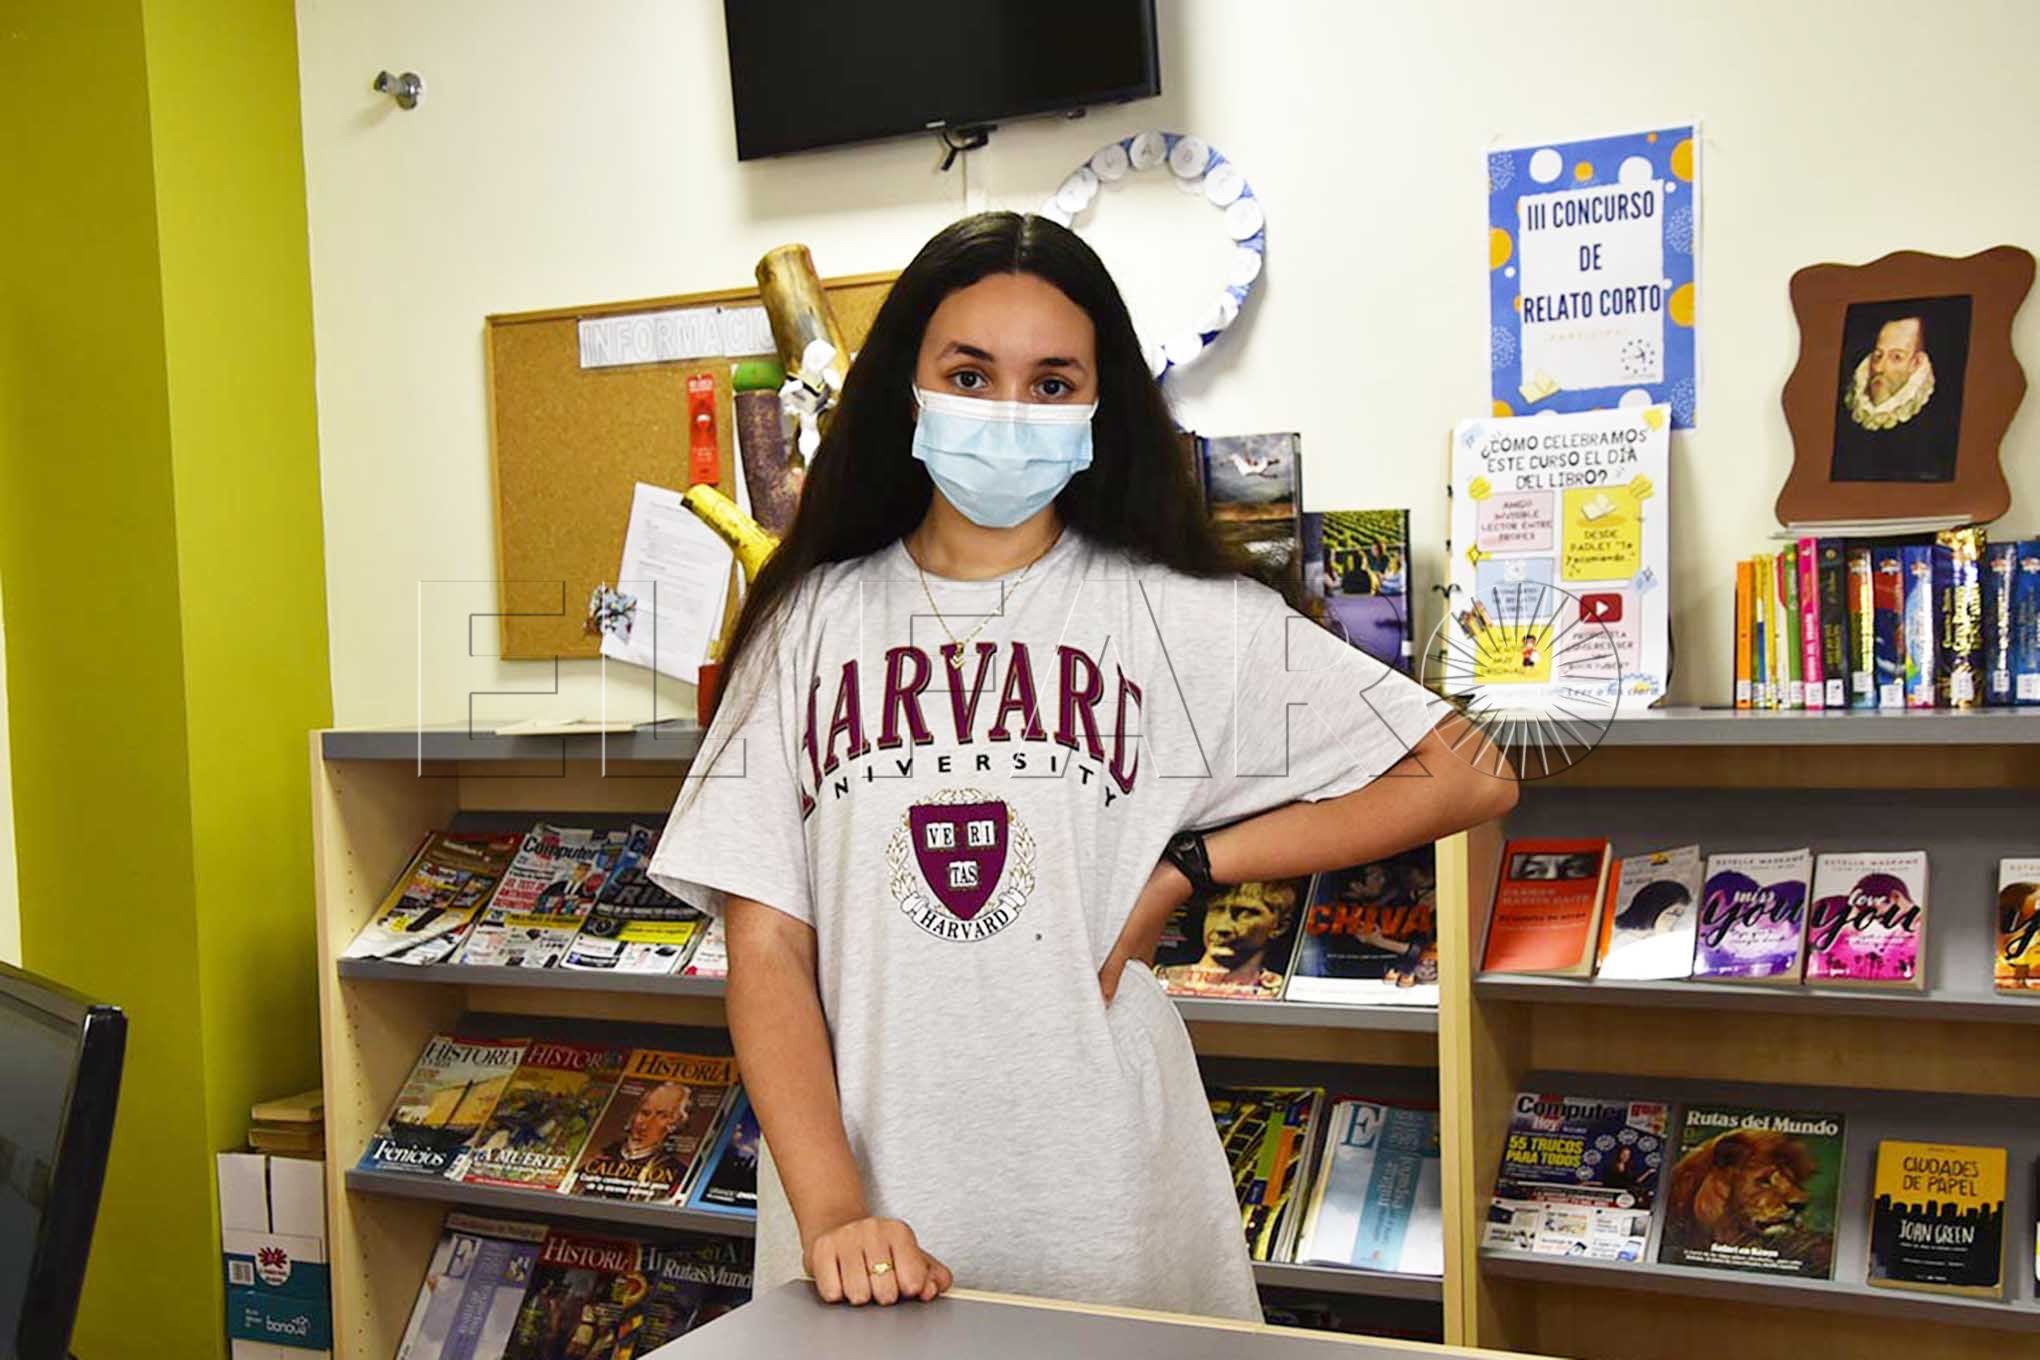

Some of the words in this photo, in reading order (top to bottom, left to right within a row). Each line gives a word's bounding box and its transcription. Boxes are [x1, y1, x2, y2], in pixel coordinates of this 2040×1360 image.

[1528, 204, 1546, 231] III
[1552, 190, 1655, 228] CONCURSO
[1579, 243, 1603, 272] DE
[1523, 291, 1593, 324] RELATO
[1599, 284, 1662, 317] CORTO
[1543, 428, 1648, 450] CELEBRAMOS
[1487, 455, 1525, 473] ESTE
[1529, 450, 1580, 470] CURSO
[1585, 450, 1601, 466] EL
[1516, 474, 1543, 490] DEL
[1549, 469, 1608, 488] LIBRO?
[834, 752, 1117, 808] NIVERSITY
[928, 826, 954, 846] VE
[969, 824, 993, 844] RI
[522, 836, 598, 861] Computer
[951, 863, 978, 885] TAS
[919, 908, 1011, 940] HARVARD
[1703, 899, 1806, 949] you
[1810, 903, 1921, 952] you
[425, 1042, 519, 1066] HISTORIA
[635, 1053, 732, 1079] HISTORIA
[1686, 1110, 1739, 1128] Rutas
[1741, 1114, 1769, 1130] del
[1771, 1117, 1839, 1136] Mundo
[373, 1139, 445, 1165] Fenicios
[1508, 1135, 1528, 1151] 55
[1530, 1137, 1585, 1155] TRUCOS
[1506, 1149, 1539, 1164] PARA
[1541, 1153, 1584, 1168] TODOS
[1903, 1156, 1980, 1179] CIUDADES
[584, 1159, 674, 1184] CALDEON
[1903, 1174, 1922, 1192] DE
[1926, 1176, 1978, 1197] PAPEL
